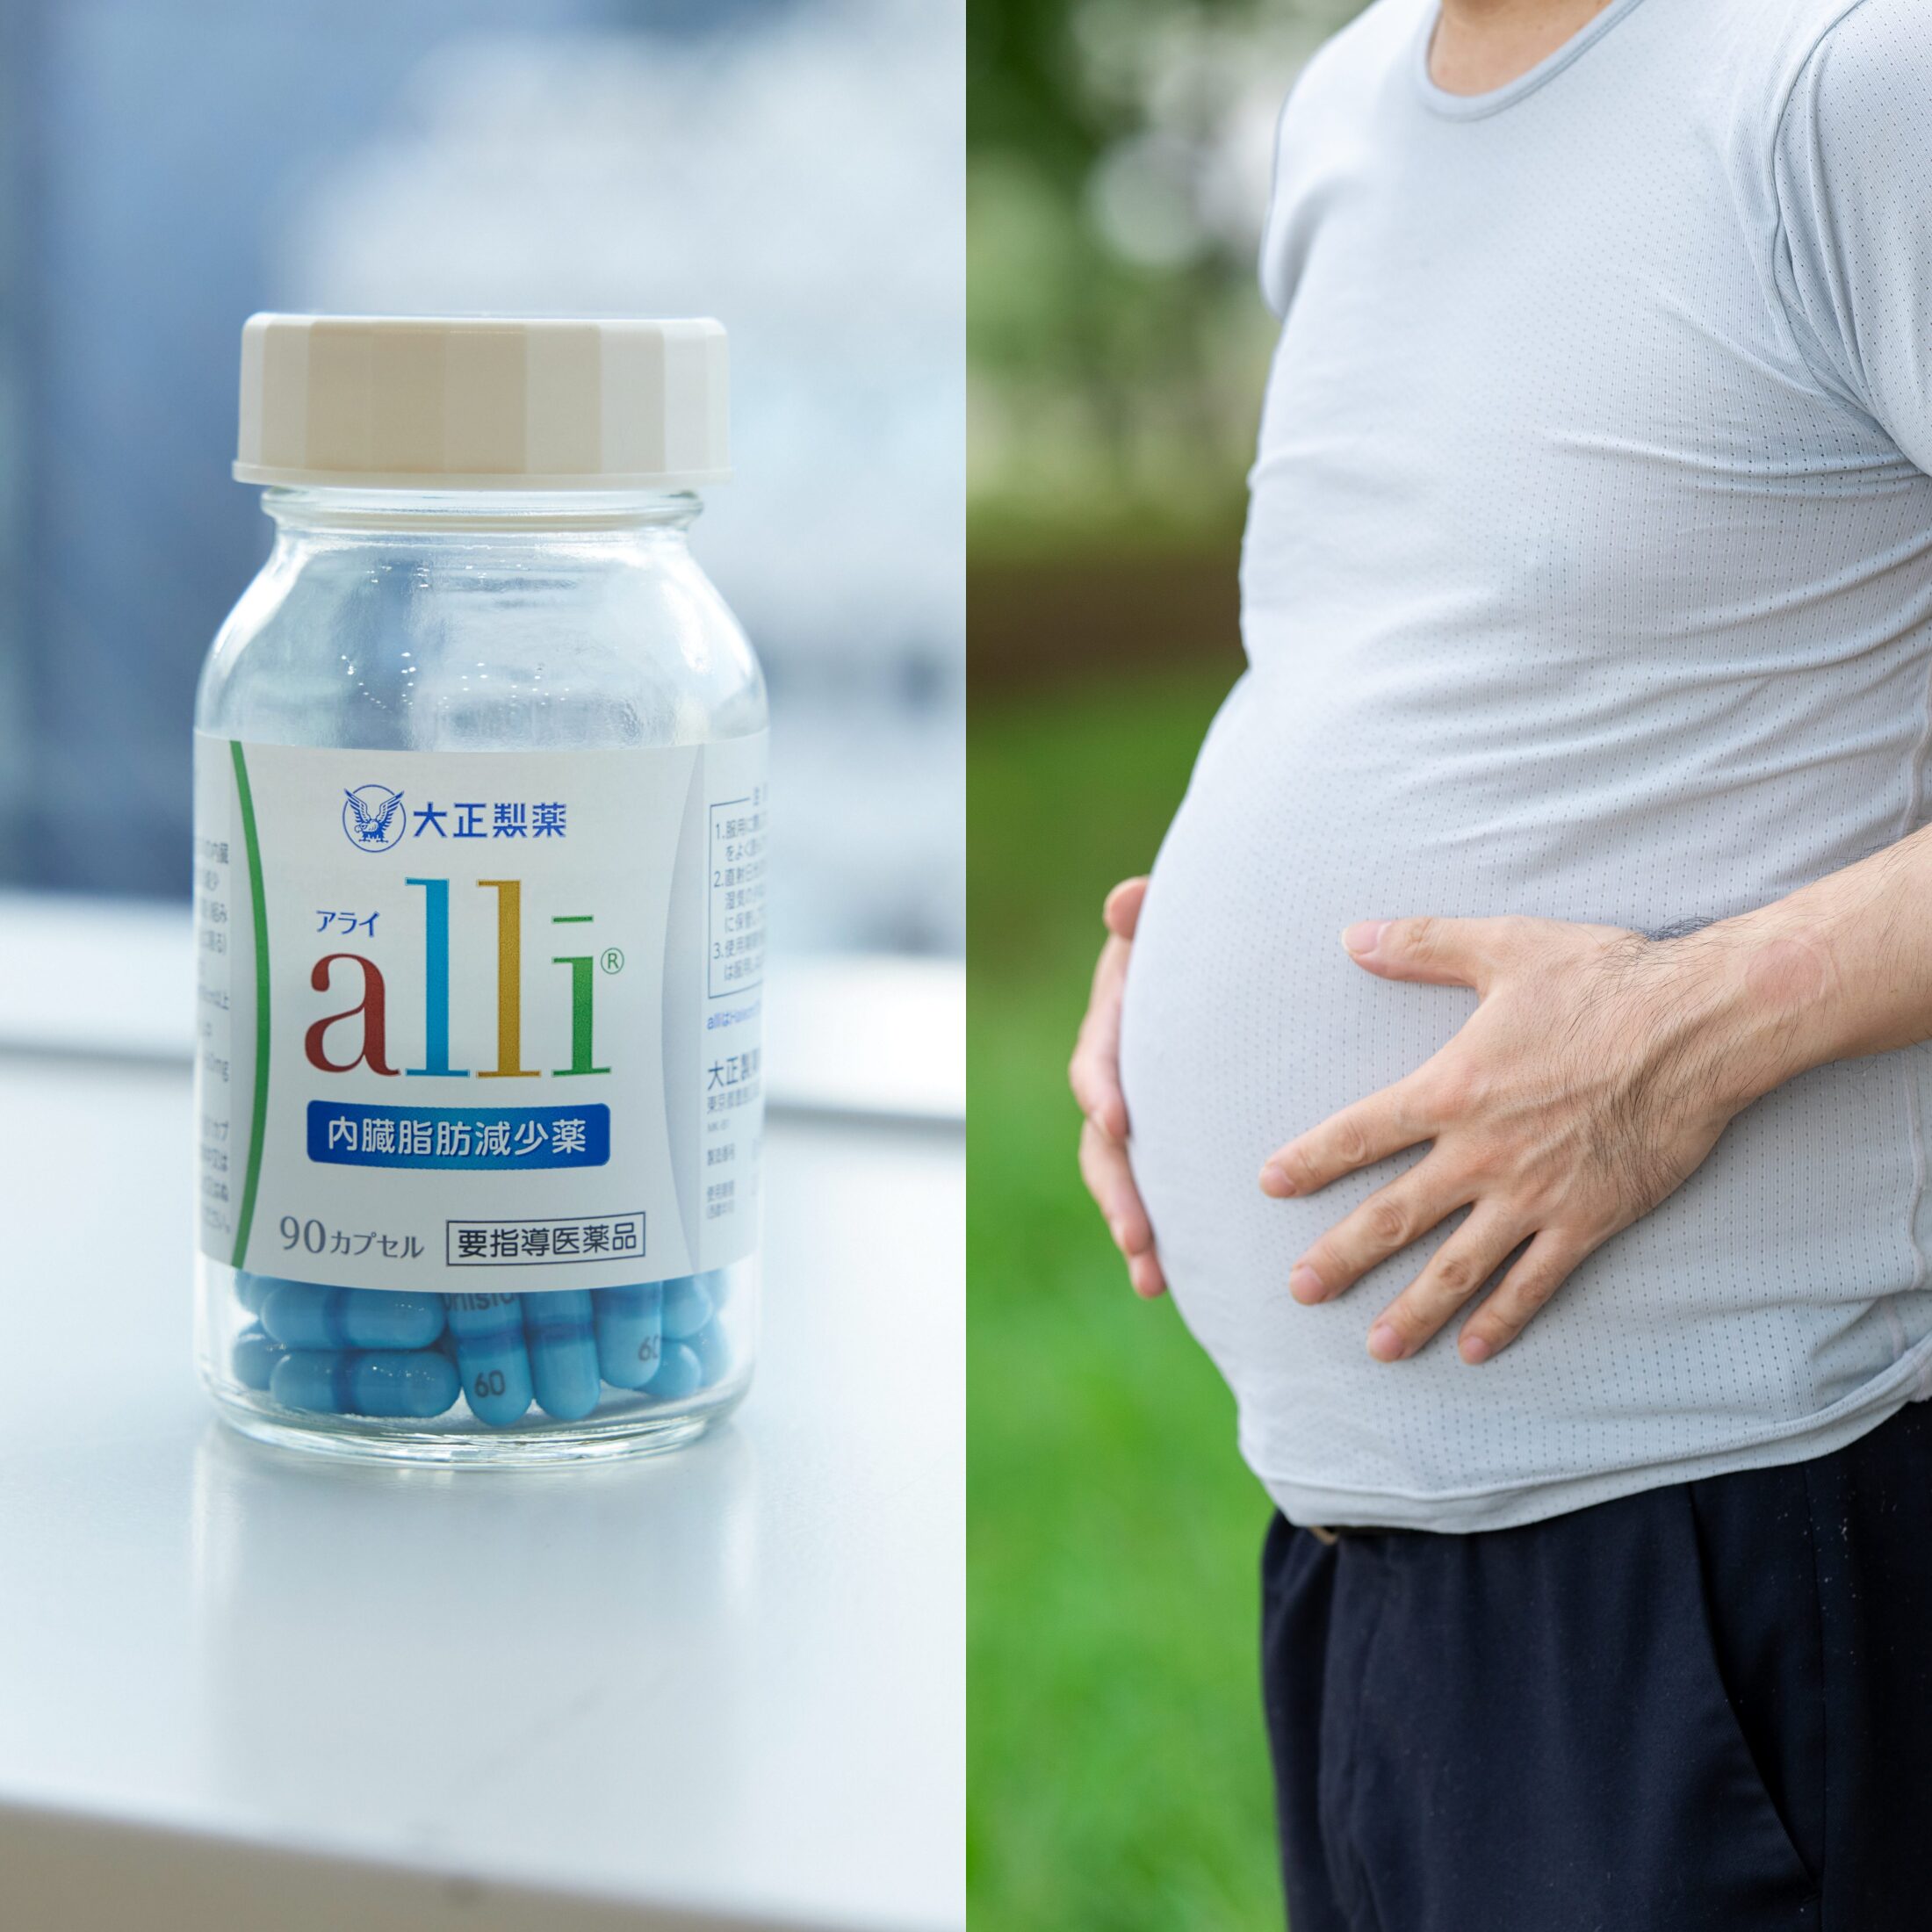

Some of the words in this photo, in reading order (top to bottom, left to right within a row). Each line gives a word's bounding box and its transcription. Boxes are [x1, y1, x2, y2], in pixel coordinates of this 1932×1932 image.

[413, 802, 566, 838] 大正製薬
[316, 911, 379, 938] アライ
[328, 1115, 587, 1157] 内臓脂肪減少薬
[458, 1222, 638, 1258] 要指導医薬品
[473, 1369, 506, 1398] 60
